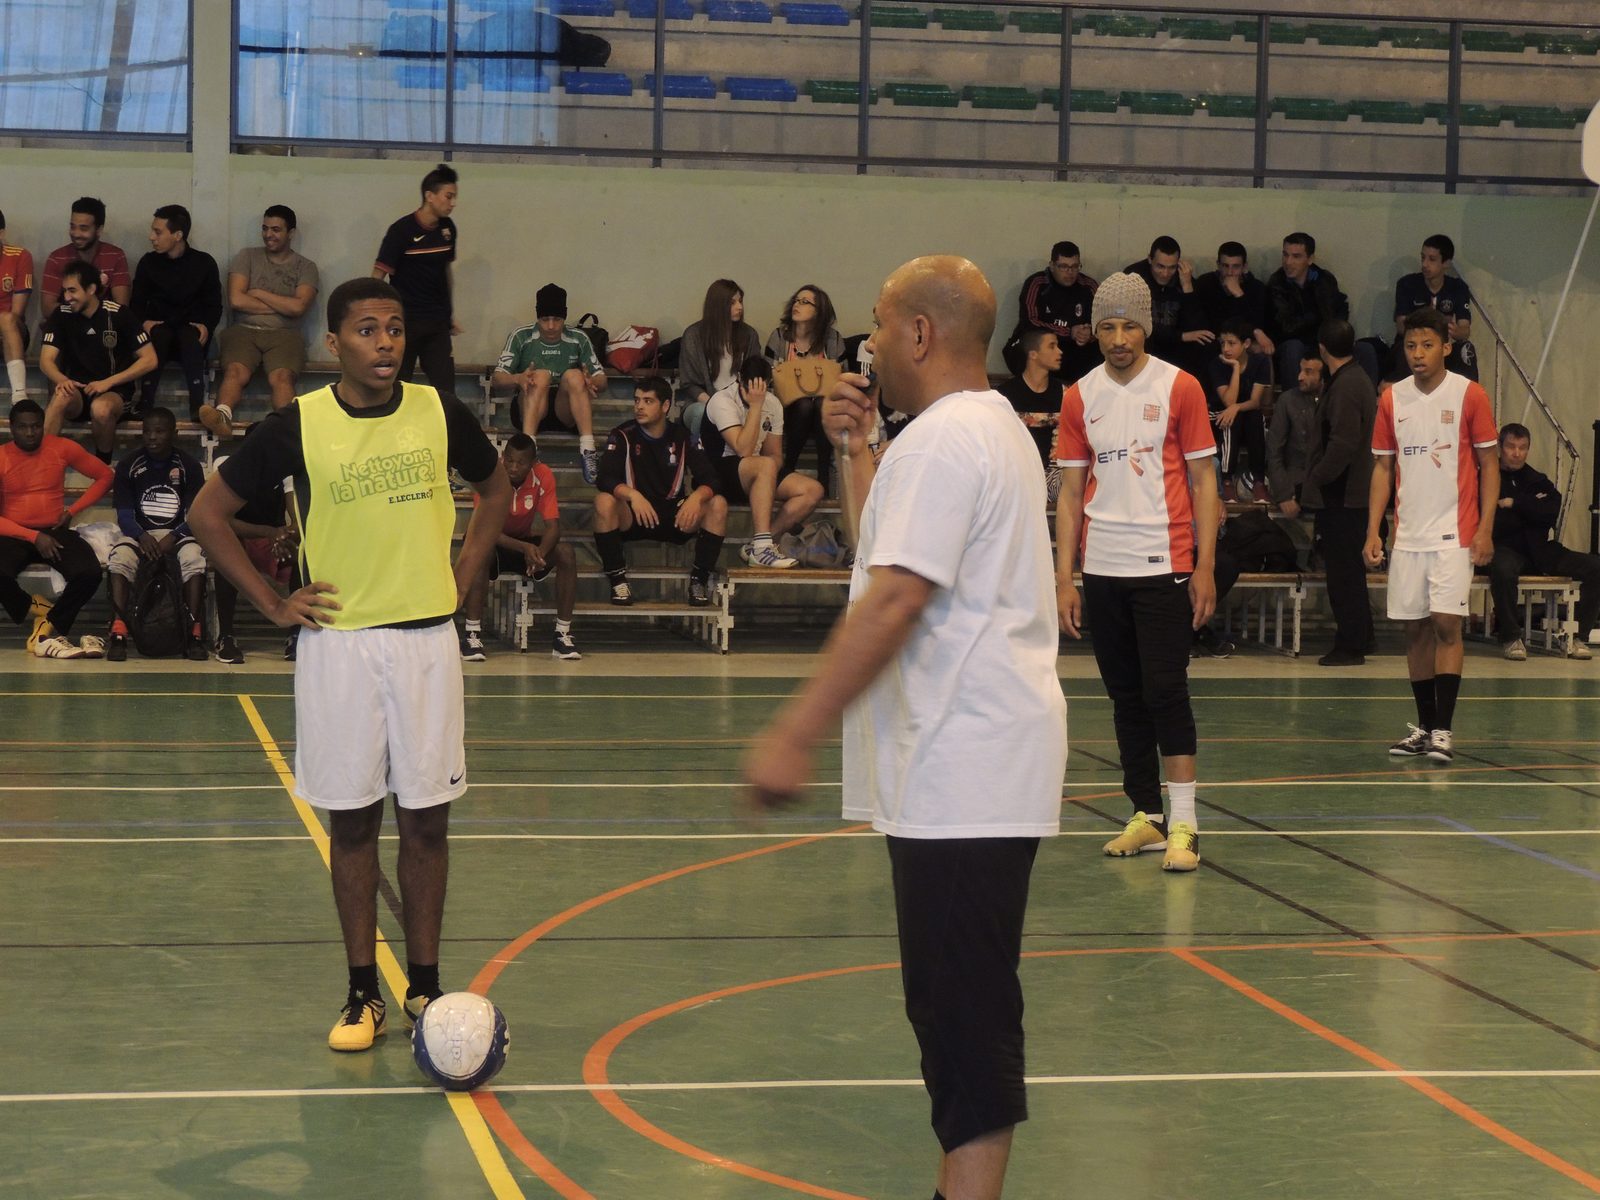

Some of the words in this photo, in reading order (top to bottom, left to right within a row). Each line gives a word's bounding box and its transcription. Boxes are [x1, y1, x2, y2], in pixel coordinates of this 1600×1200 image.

[1097, 449, 1128, 464] ETF
[1403, 446, 1428, 456] ETF
[340, 448, 432, 482] Nettoyons
[329, 481, 355, 505] la
[359, 459, 436, 498] nature!
